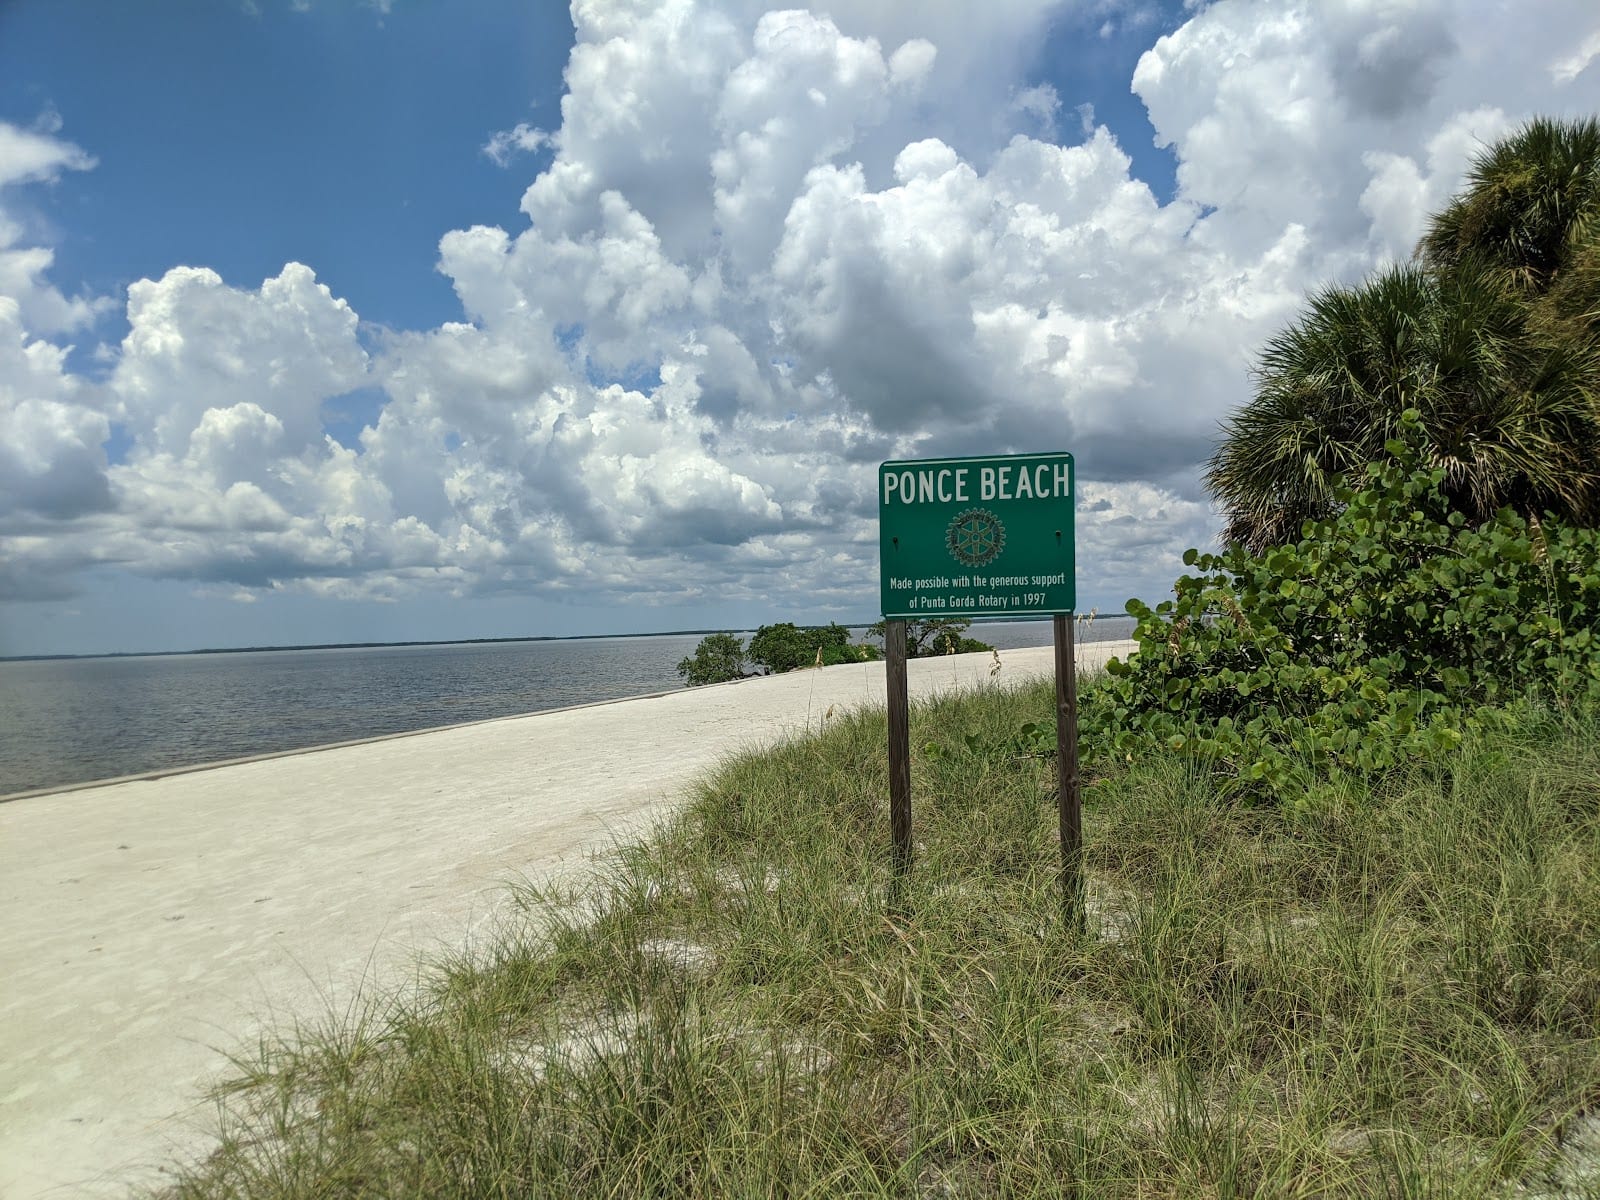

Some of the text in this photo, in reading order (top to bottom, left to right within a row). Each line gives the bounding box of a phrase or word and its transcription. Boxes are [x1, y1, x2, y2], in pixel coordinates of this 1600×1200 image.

[884, 463, 1069, 505] PONCE BEACH
[890, 573, 1065, 591] Made possible with the generous support
[909, 593, 1046, 608] of Punta Gorda Rotary in 1997
